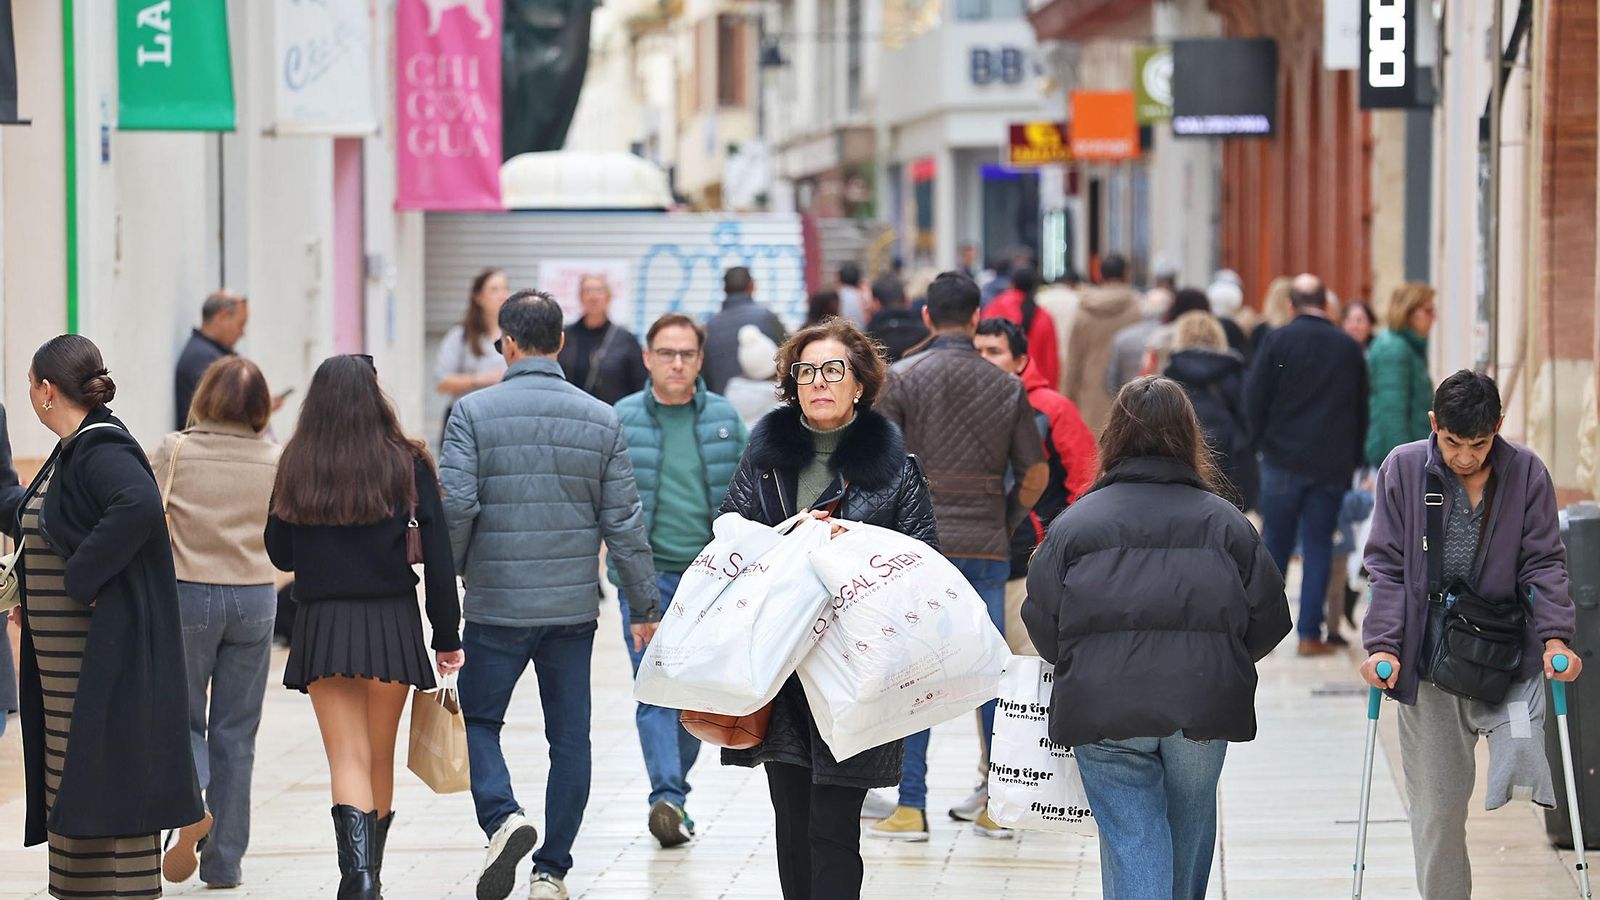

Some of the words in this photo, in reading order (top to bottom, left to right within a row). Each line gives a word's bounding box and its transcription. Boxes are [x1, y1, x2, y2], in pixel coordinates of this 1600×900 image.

[137, 0, 172, 67] LA
[1005, 712, 1046, 722] copenhagen
[989, 761, 1020, 777] flying
[1022, 767, 1054, 781] tiger
[998, 776, 1039, 787] copenhagen
[1030, 801, 1066, 817] flying
[1042, 814, 1082, 824] copenhagen
